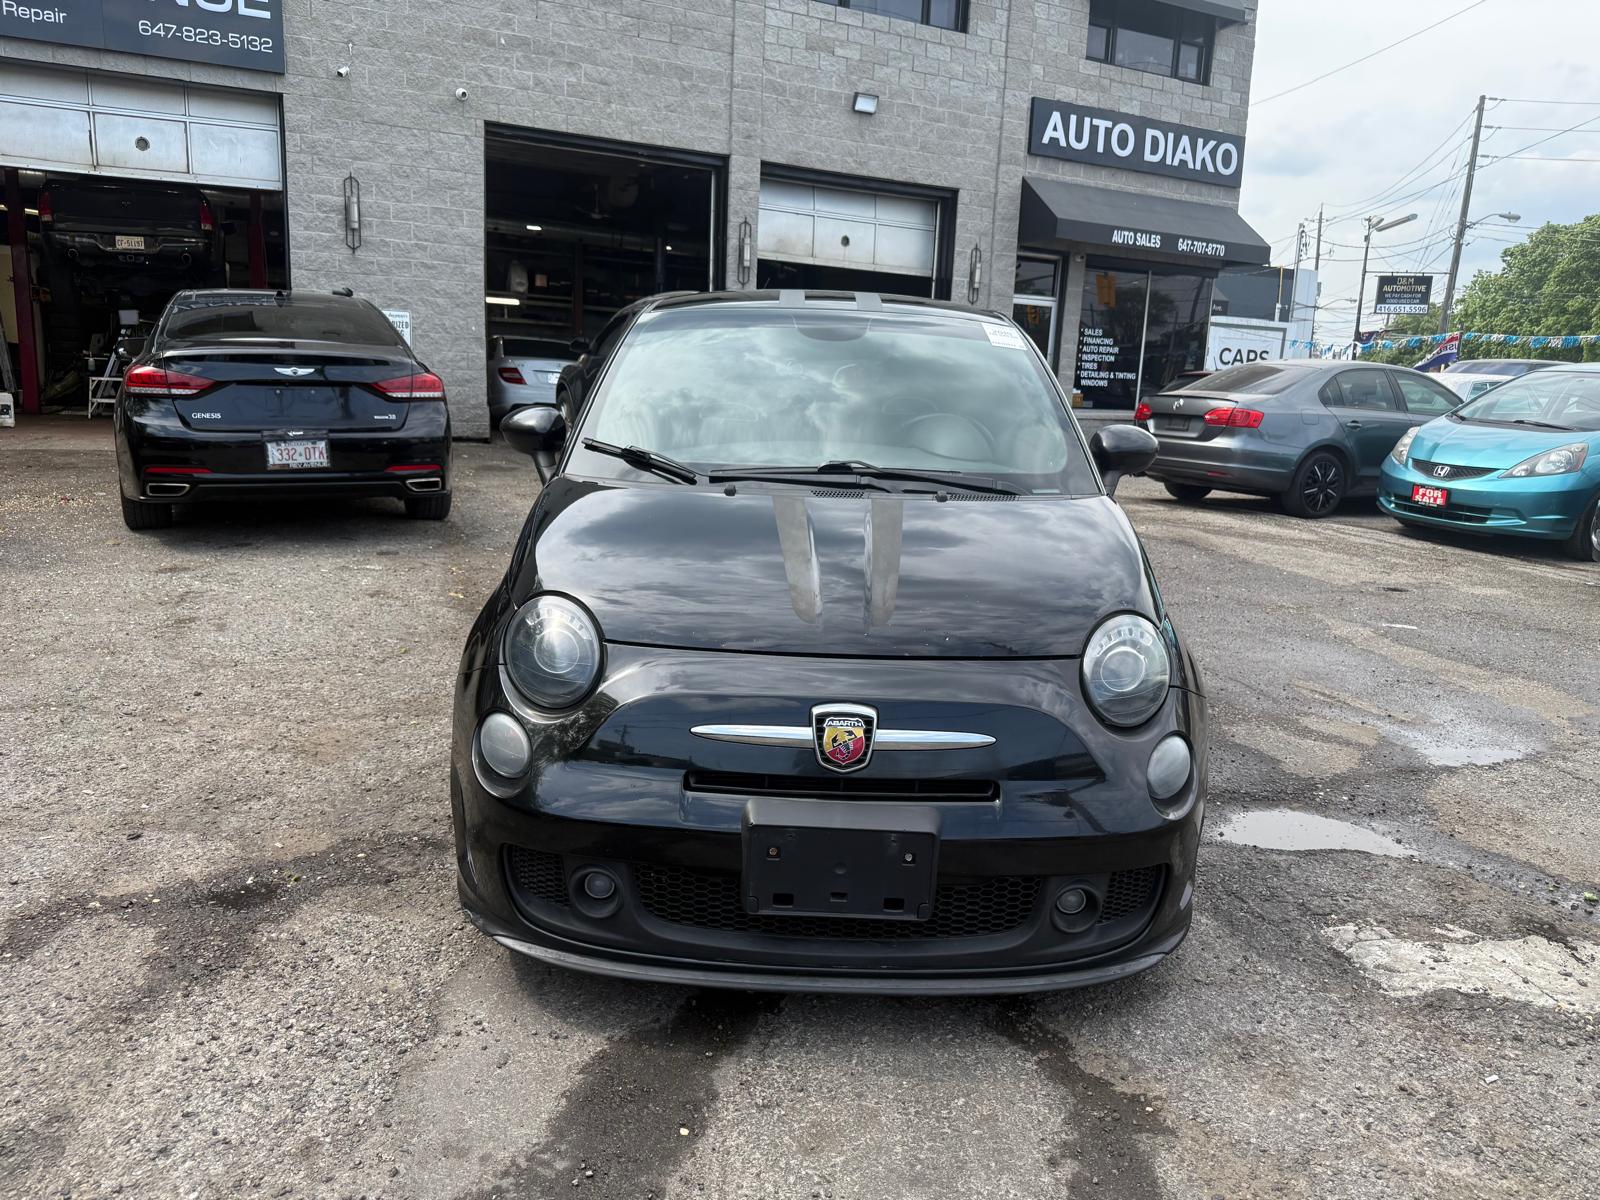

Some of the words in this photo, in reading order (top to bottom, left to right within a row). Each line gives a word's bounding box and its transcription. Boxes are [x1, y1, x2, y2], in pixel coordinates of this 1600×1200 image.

[2, 0, 67, 24] Repair
[138, 20, 273, 53] 647-823-5132
[1041, 111, 1135, 157] AUTO
[1144, 128, 1238, 176] DIAKO
[1112, 229, 1135, 245] AUTO
[1136, 232, 1161, 248] SALES
[1178, 238, 1225, 256] 647-707-8770
[1377, 305, 1427, 313] 416.651.5596
[1084, 328, 1103, 336] SALES
[1083, 337, 1113, 345] FINANCING
[1082, 345, 1098, 353] AUTO
[1099, 346, 1119, 354] REPAIR
[1081, 354, 1115, 362] INSPECTION
[1080, 379, 1108, 387] WINDOWS
[1418, 488, 1442, 498] FOR
[1415, 494, 1444, 505] SALE
